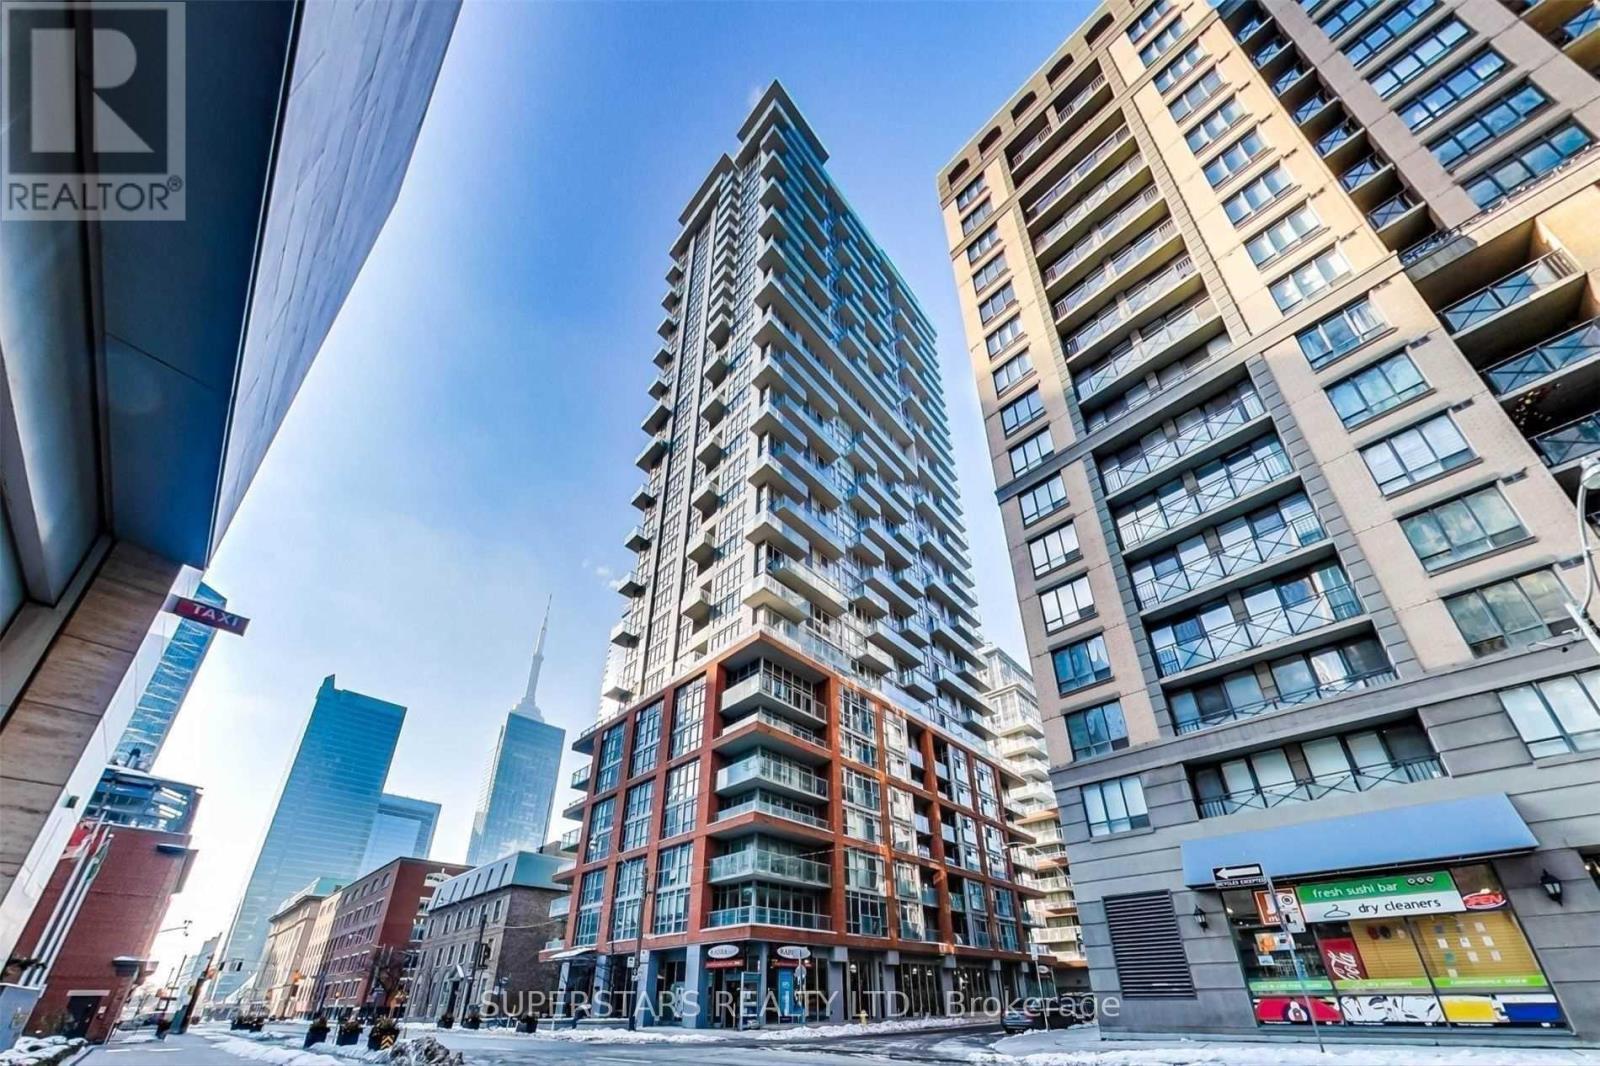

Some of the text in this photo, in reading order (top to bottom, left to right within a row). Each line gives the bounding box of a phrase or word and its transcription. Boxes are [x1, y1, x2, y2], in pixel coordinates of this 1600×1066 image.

[192, 603, 240, 626] TAXI
[1312, 882, 1398, 899] fresh sushi bar
[1358, 898, 1442, 915] dry cleaners
